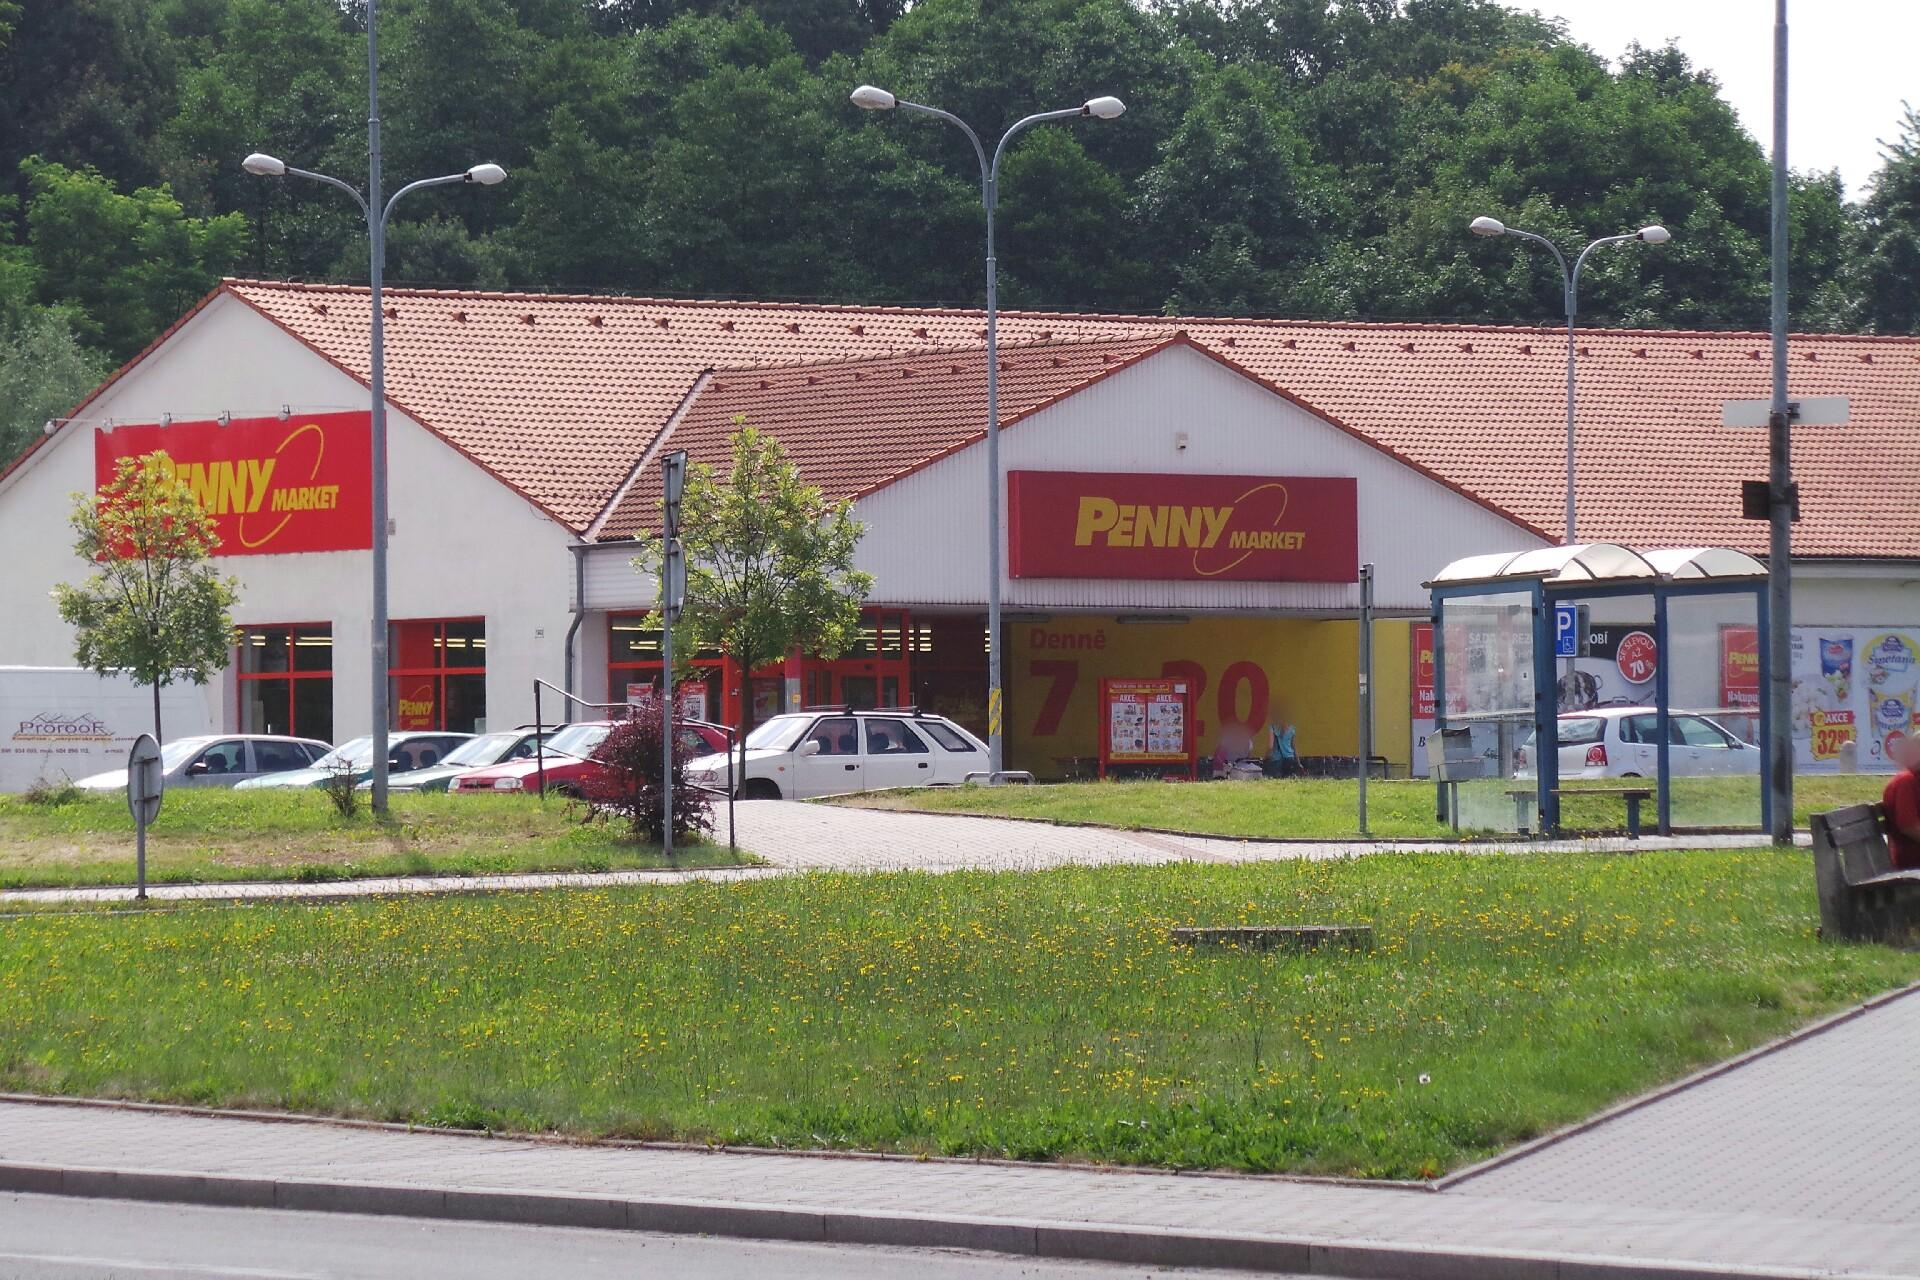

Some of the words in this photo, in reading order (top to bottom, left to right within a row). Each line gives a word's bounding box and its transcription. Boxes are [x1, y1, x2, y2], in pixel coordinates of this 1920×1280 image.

[271, 485, 340, 512] MARKET
[1075, 496, 1235, 549] PENNY
[1229, 531, 1306, 551] MARKET
[1557, 611, 1571, 641] P
[1590, 631, 1608, 645] OBÍ
[1729, 652, 1758, 665] PENN
[1630, 660, 1645, 678] 70
[1030, 659, 1079, 736] 7
[400, 699, 433, 716] PENNY
[1825, 713, 1848, 722] AKCE
